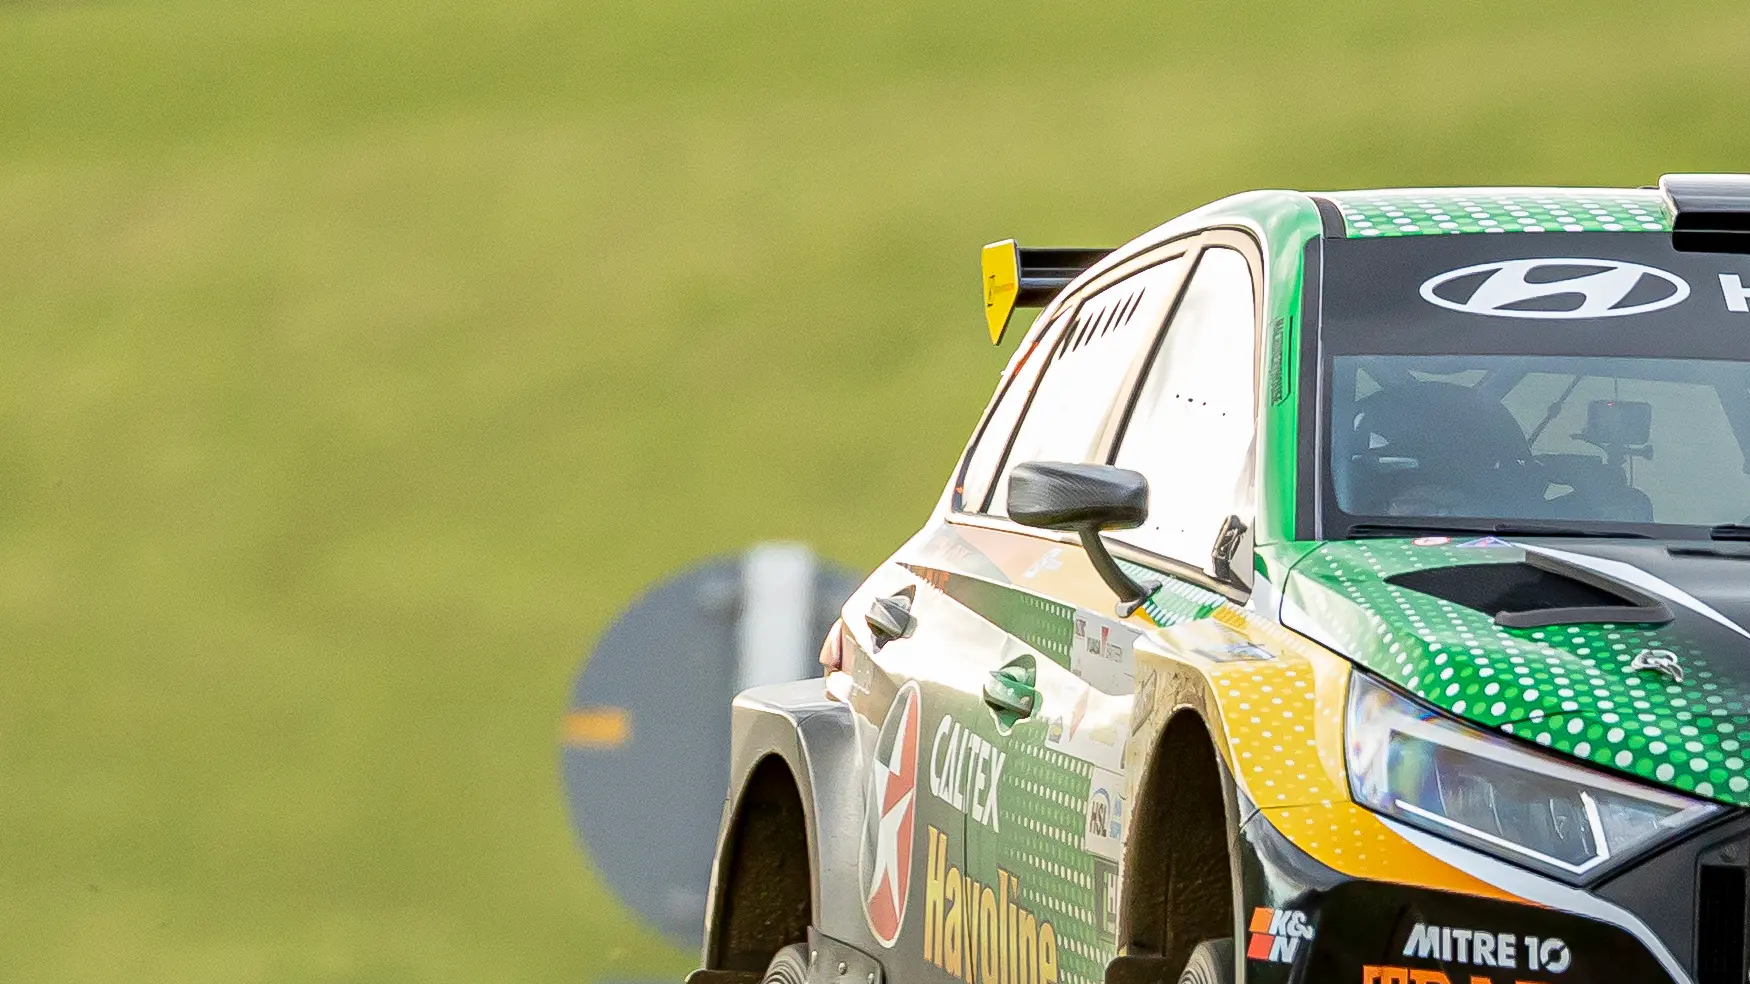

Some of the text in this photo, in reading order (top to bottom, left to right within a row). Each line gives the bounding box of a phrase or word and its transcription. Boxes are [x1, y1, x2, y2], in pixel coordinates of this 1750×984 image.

[929, 713, 1006, 833] CALTEX
[1402, 922, 1572, 974] MITRE 10
